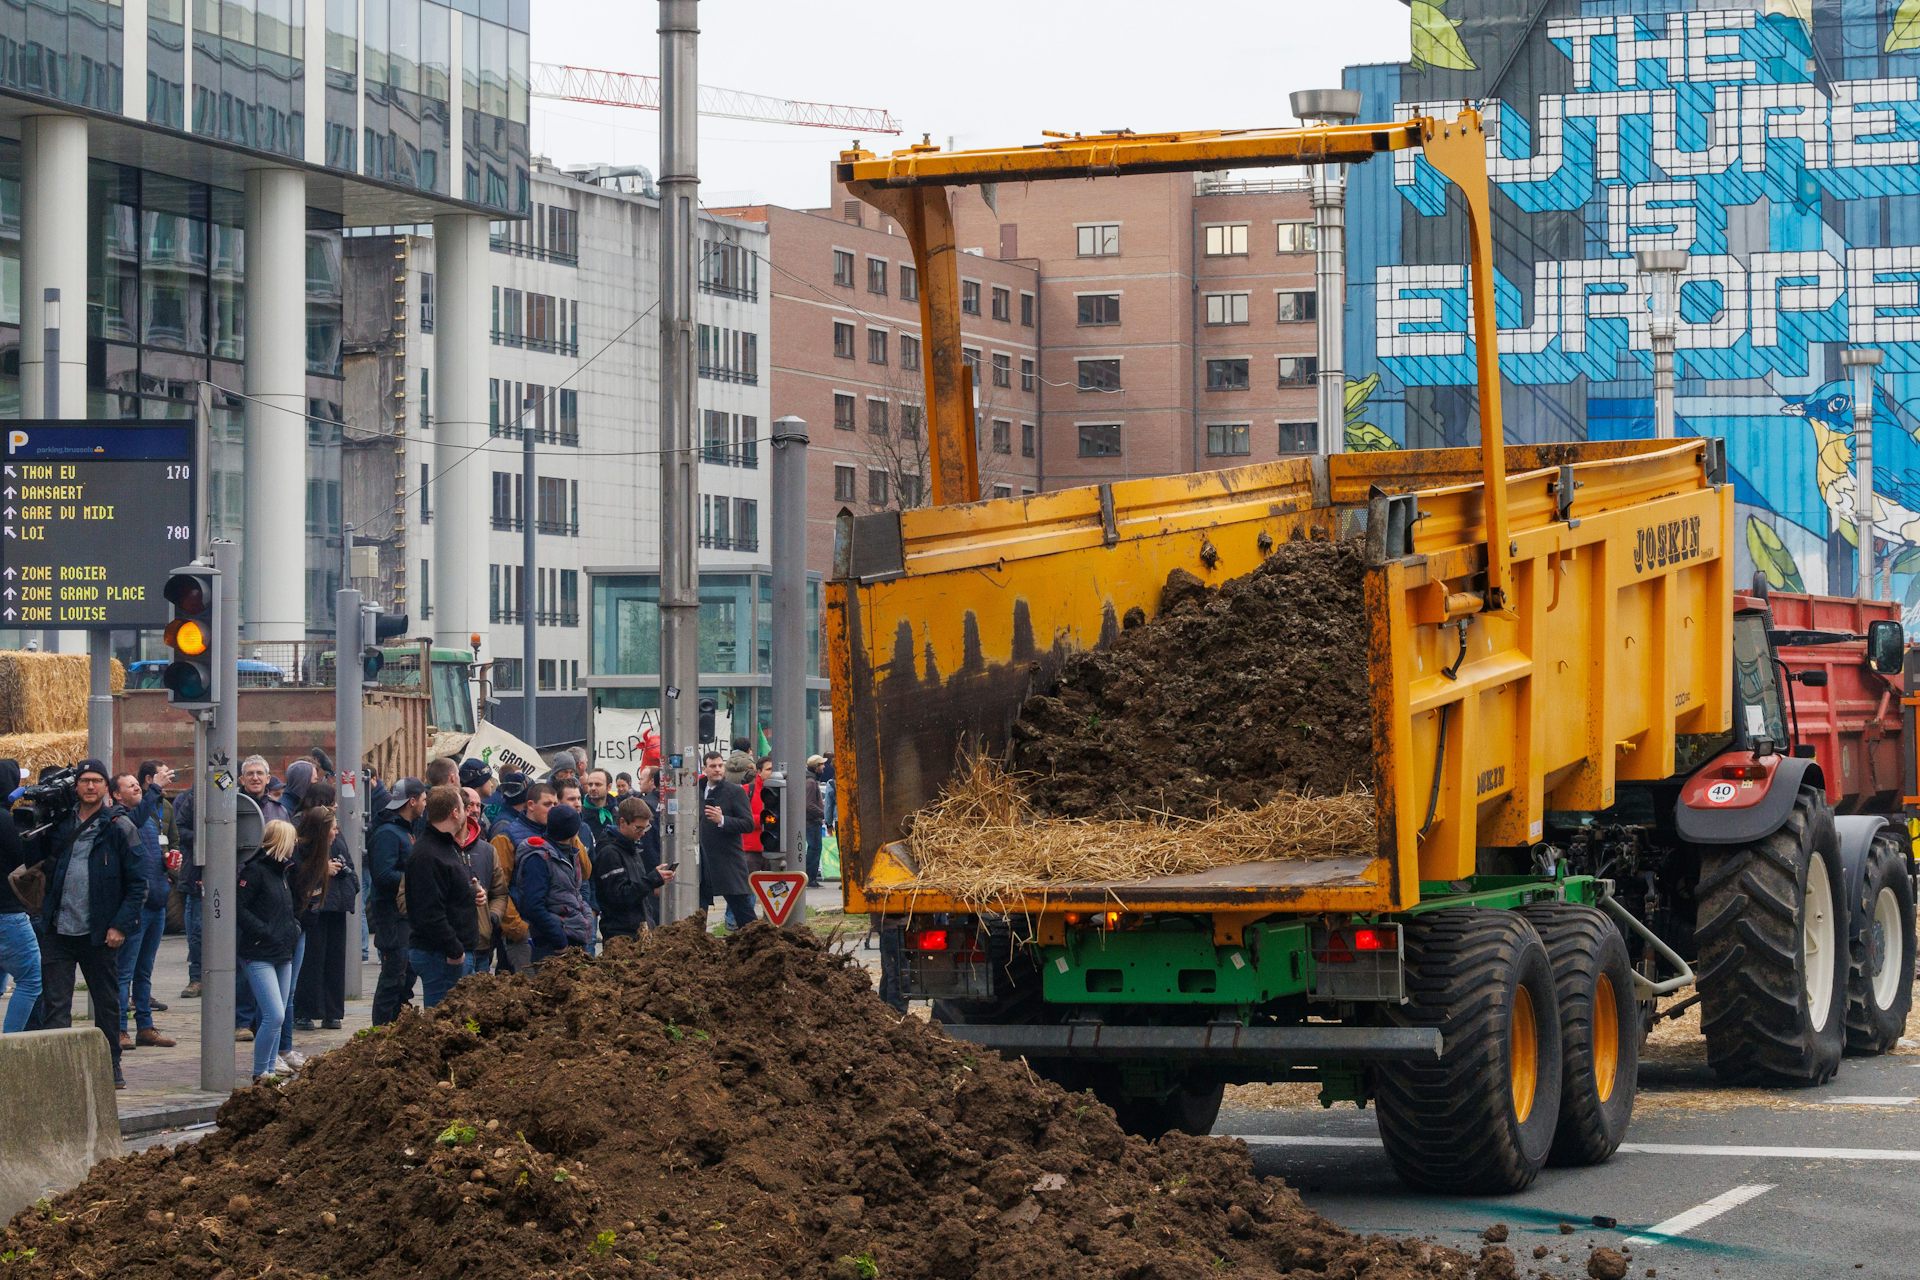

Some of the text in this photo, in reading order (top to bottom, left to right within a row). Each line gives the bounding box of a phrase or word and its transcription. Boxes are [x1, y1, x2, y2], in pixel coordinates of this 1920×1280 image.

[1546, 10, 1757, 88] THE
[1393, 76, 1919, 187] FUTURE
[1607, 180, 1698, 254] IS
[1376, 247, 1920, 358] EUROPE
[9, 430, 29, 454] P
[36, 446, 94, 455] parking.brussels
[22, 465, 190, 480] THON EU 170
[22, 486, 84, 500] DANSAERT
[22, 506, 115, 520] GARE DU MIDI
[22, 526, 190, 540] LOI 780
[1634, 516, 1700, 574] JOSKIN
[22, 567, 107, 581] ZONE ROGIER
[22, 587, 145, 601] ZONE GRAND PLACE
[22, 607, 107, 621] ZONE LOUISE
[598, 741, 625, 760] LES
[499, 749, 536, 776] GROND
[1712, 786, 1732, 796] 40
[213, 888, 221, 919] A03
